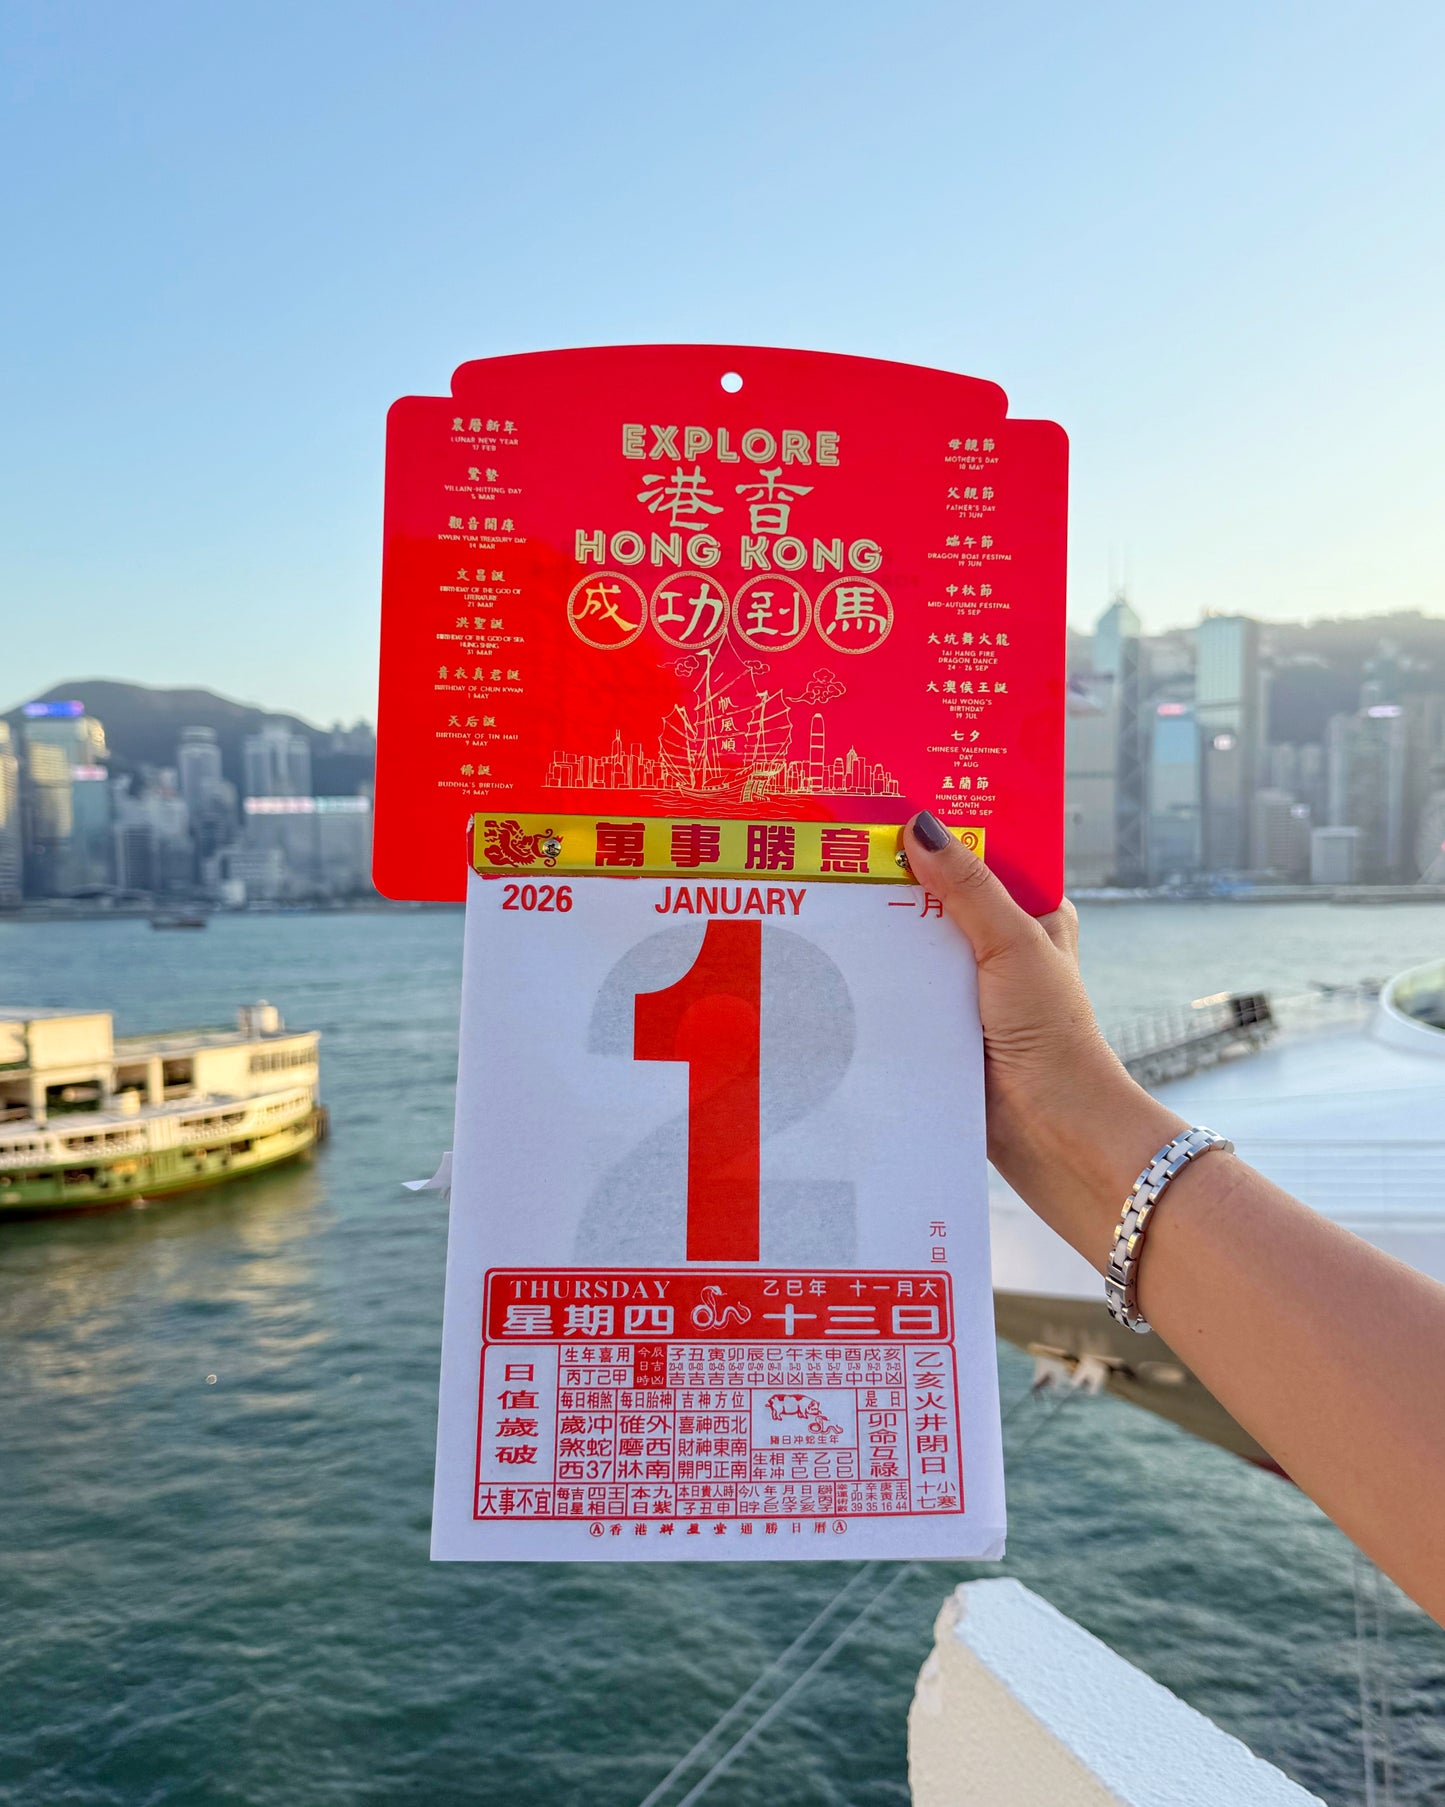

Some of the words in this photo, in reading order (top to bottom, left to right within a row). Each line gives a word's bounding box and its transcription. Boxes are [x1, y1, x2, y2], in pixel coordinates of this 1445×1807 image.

[623, 423, 840, 466] EXPLORE
[948, 438, 995, 452] 母親節
[947, 486, 994, 500] 父親節
[575, 530, 721, 567] HONG
[741, 536, 882, 573] KONG
[946, 535, 993, 549] 端午節
[946, 584, 992, 597] 中秋節
[951, 730, 980, 742] 七夕
[595, 823, 870, 873] 萬事勝意
[502, 884, 573, 913] 2026
[655, 887, 807, 916] JANUARY
[888, 892, 943, 918] 一月
[634, 920, 762, 1261] 1
[929, 1220, 947, 1263] 元旦
[509, 1279, 671, 1299] THURSDAY
[763, 1279, 827, 1295] 乙巳年
[850, 1279, 937, 1298] 十一月大
[502, 1304, 674, 1336] 星期四
[763, 1304, 939, 1335] 十三日
[565, 1347, 630, 1363] 生年喜用
[561, 1391, 613, 1409] 每日相煞
[620, 1391, 672, 1409] 每日胎神
[682, 1391, 745, 1409] 吉神方位
[679, 1415, 747, 1434] 喜神西北
[678, 1438, 747, 1457] 財神東南
[678, 1460, 747, 1479] 開門正南
[480, 1487, 551, 1515] 大事不宜
[851, 1502, 863, 1512] 39
[866, 1502, 878, 1512] 35
[881, 1502, 893, 1511] 16
[895, 1501, 907, 1511] 44
